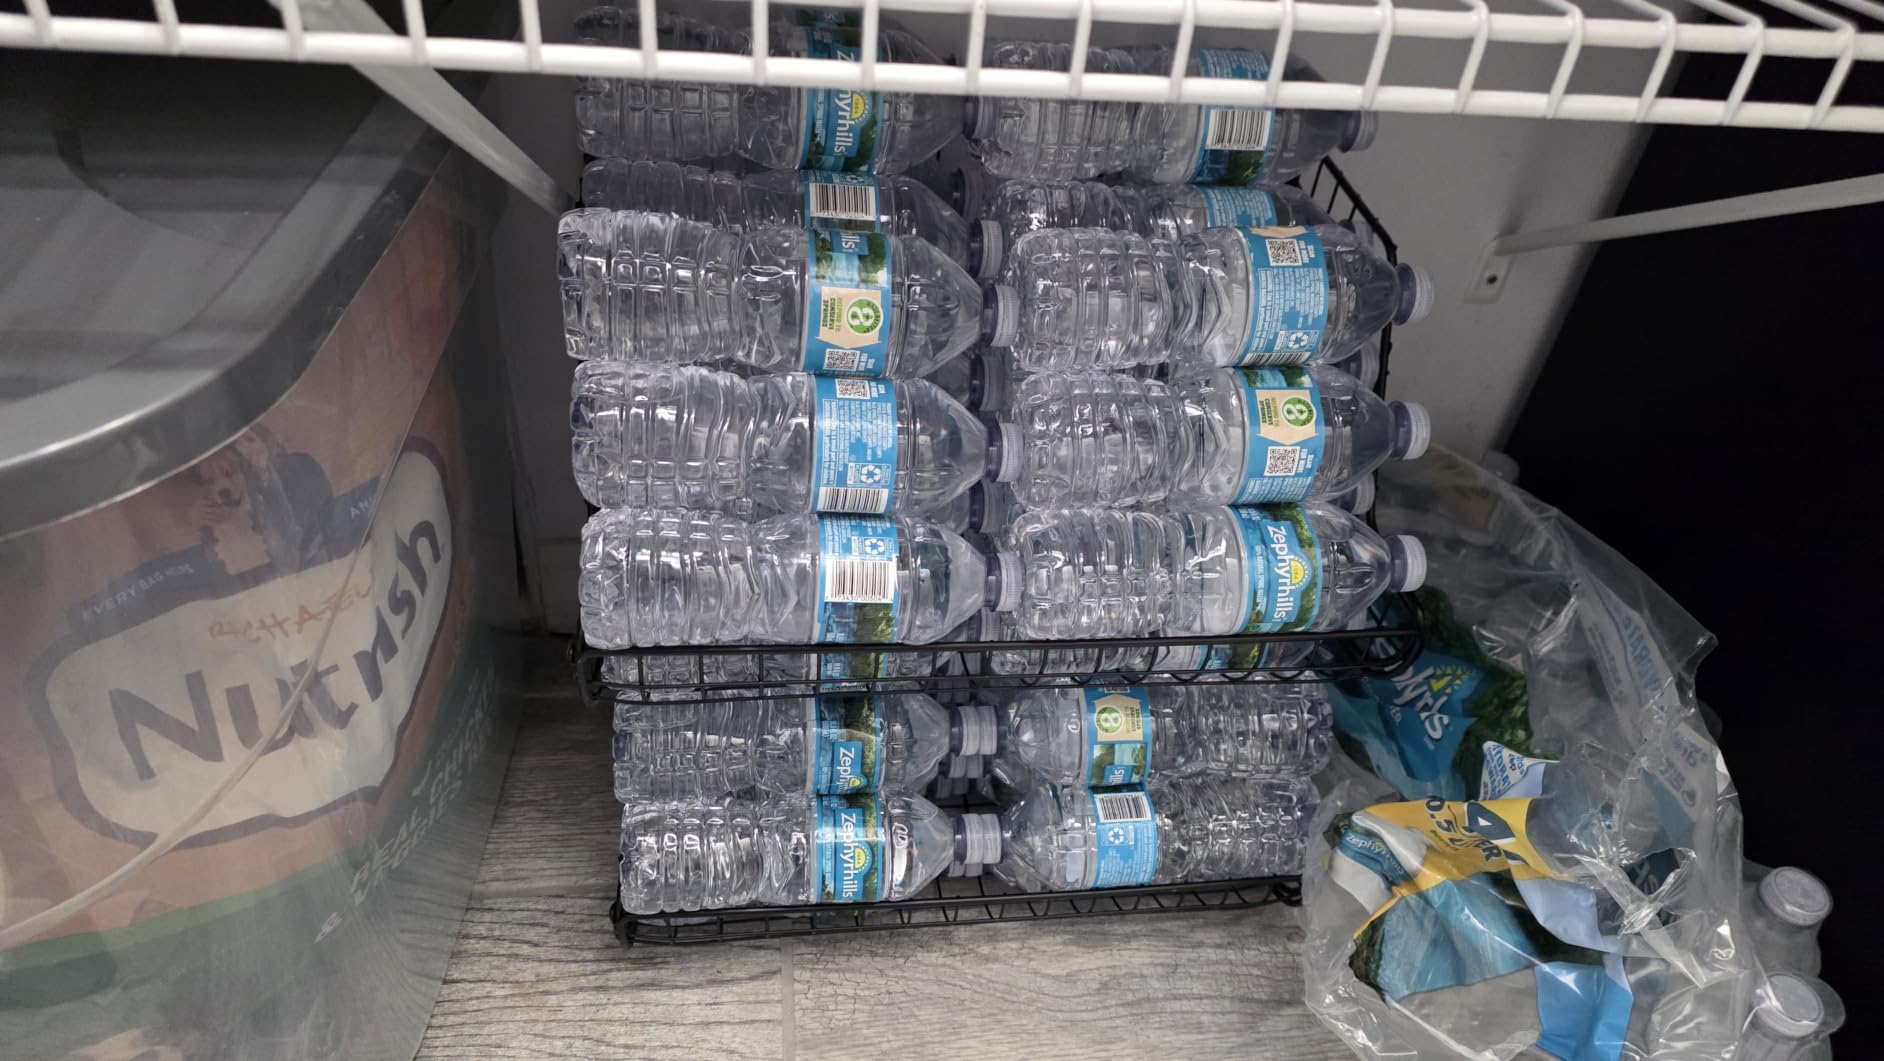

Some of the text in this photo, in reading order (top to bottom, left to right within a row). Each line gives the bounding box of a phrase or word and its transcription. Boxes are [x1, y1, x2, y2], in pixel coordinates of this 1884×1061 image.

[1266, 525, 1295, 619] Zephyrhills
[108, 520, 441, 782] Nutrsh
[840, 812, 859, 898] Zephyrhills
